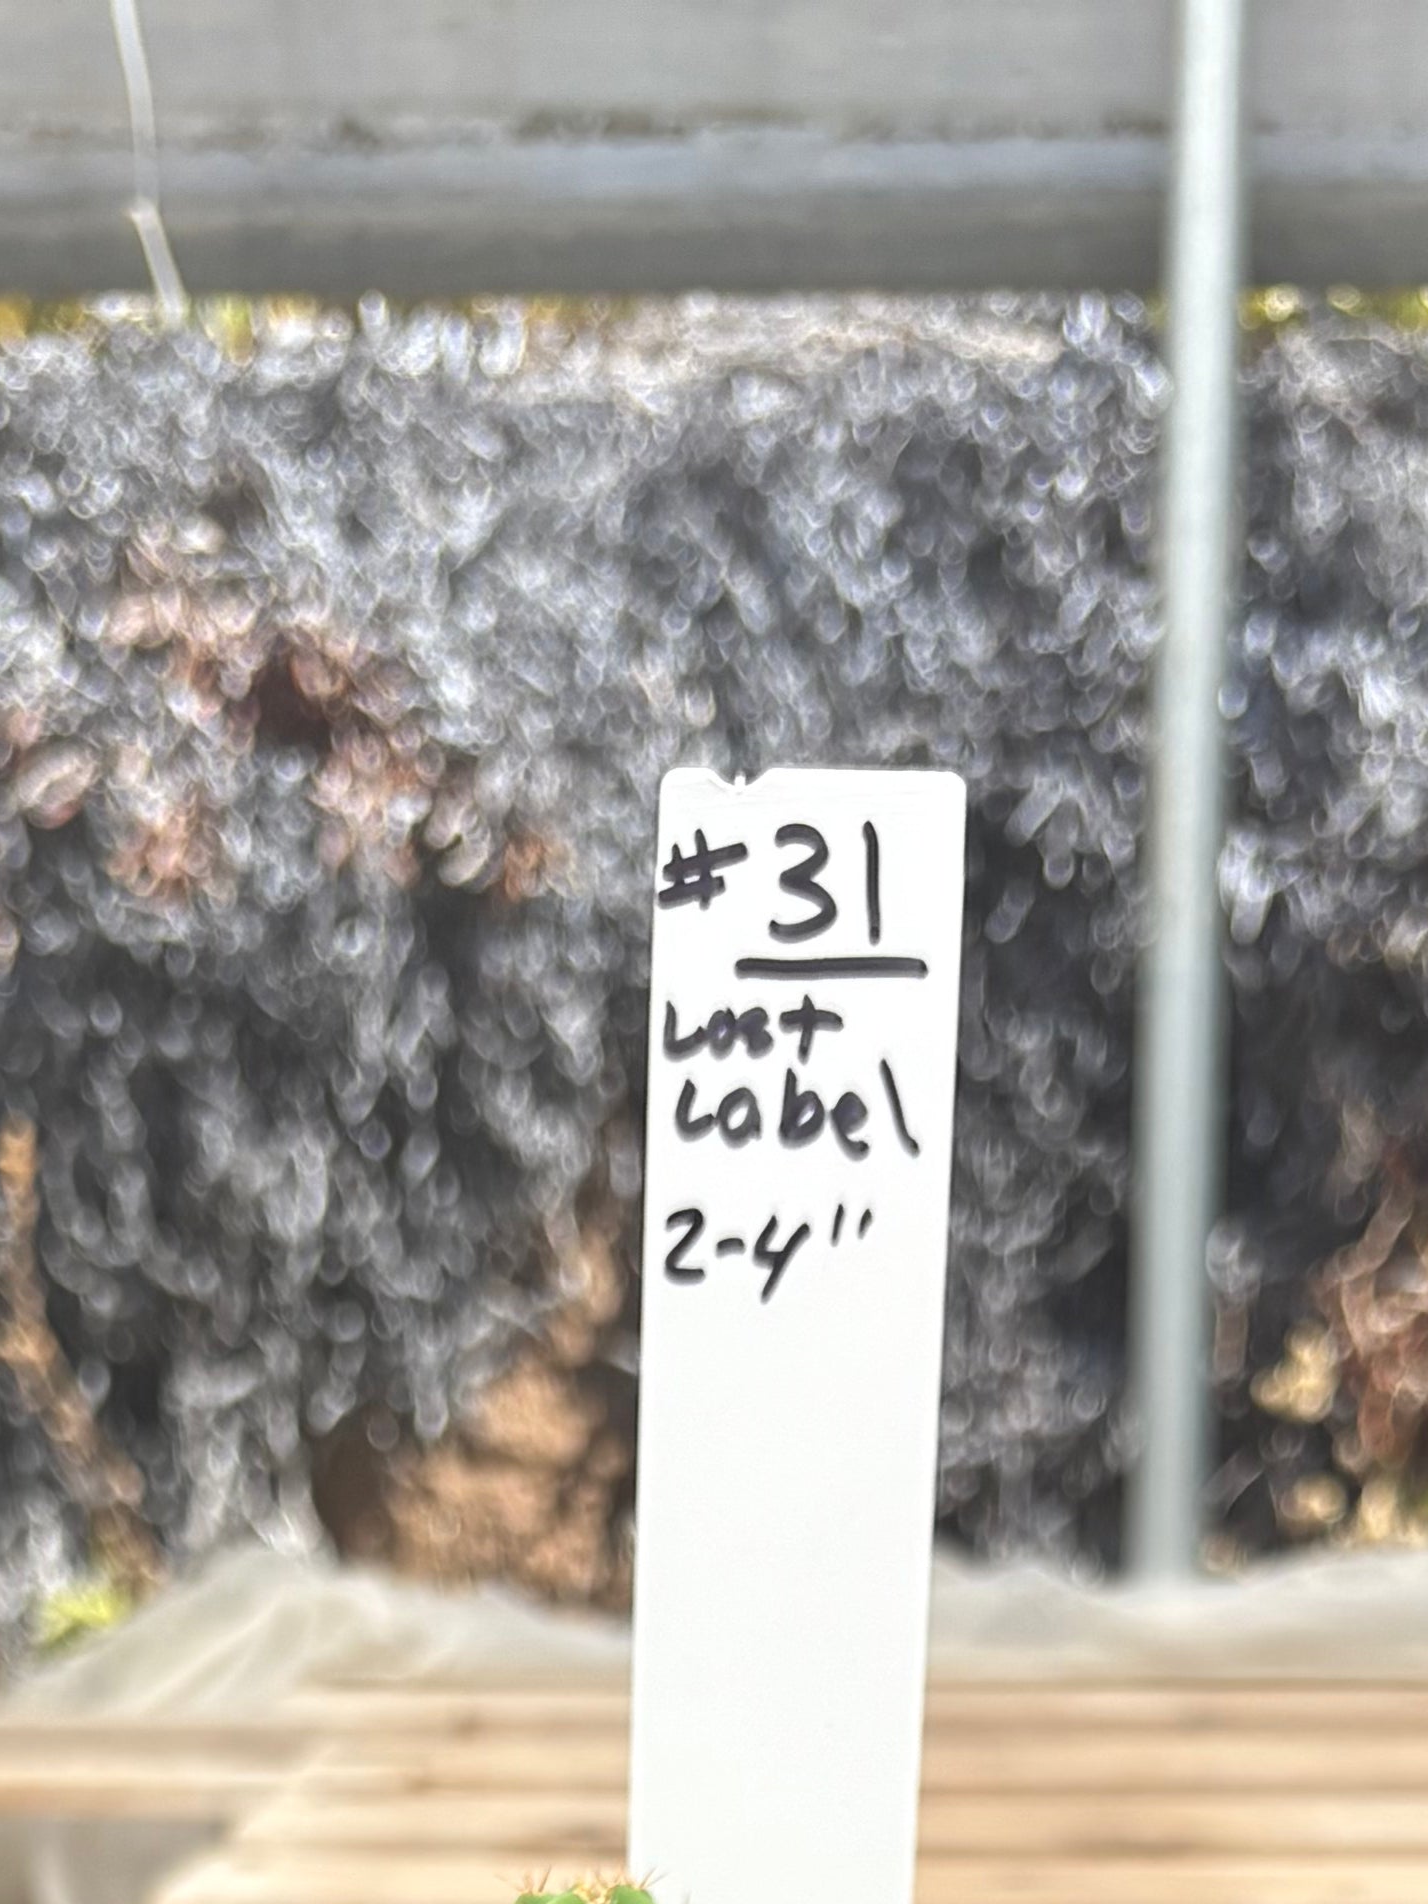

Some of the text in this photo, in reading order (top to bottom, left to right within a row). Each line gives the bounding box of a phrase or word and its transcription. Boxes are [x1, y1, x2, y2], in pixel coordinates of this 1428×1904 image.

[657, 820, 883, 945] #31
[662, 994, 845, 1063] Lost
[674, 1057, 921, 1160] Label
